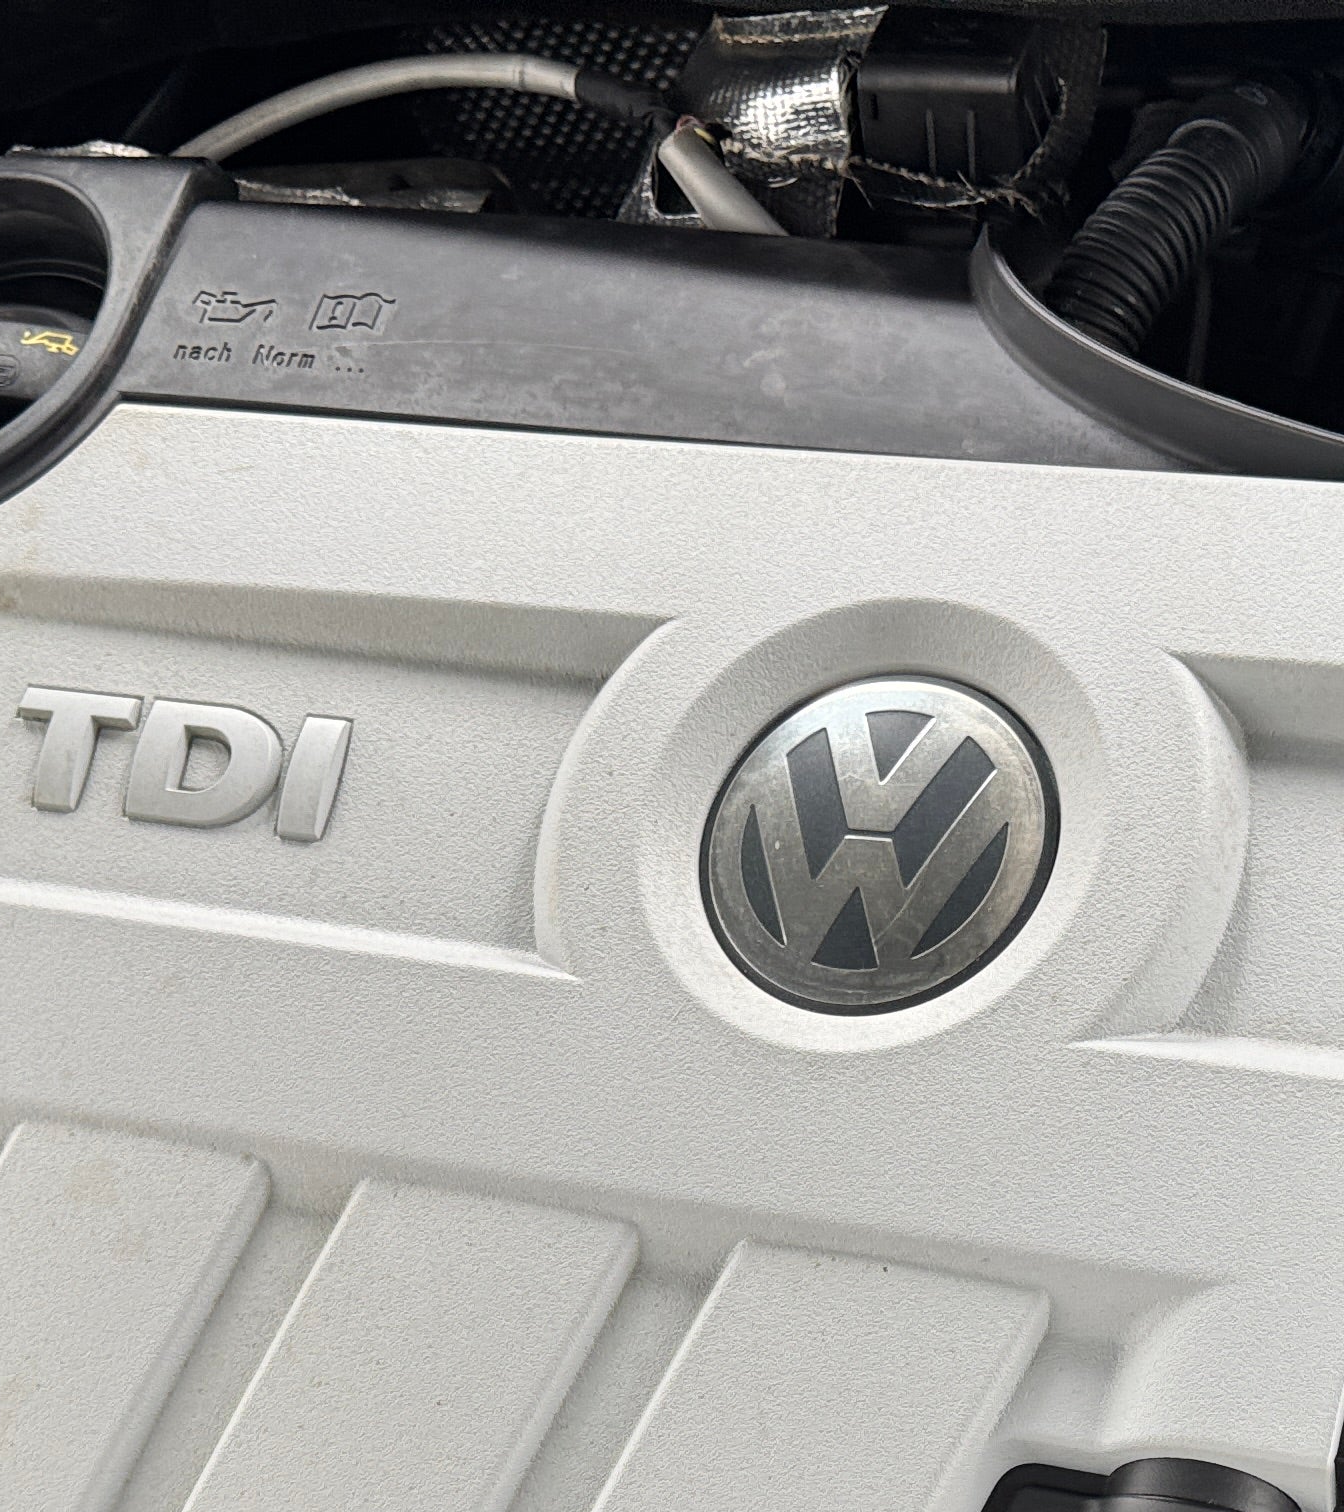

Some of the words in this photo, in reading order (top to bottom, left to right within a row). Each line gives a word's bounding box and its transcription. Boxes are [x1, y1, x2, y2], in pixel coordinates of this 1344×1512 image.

[173, 342, 233, 364] nach
[252, 343, 316, 370] Norm
[17, 684, 354, 842] TDI
